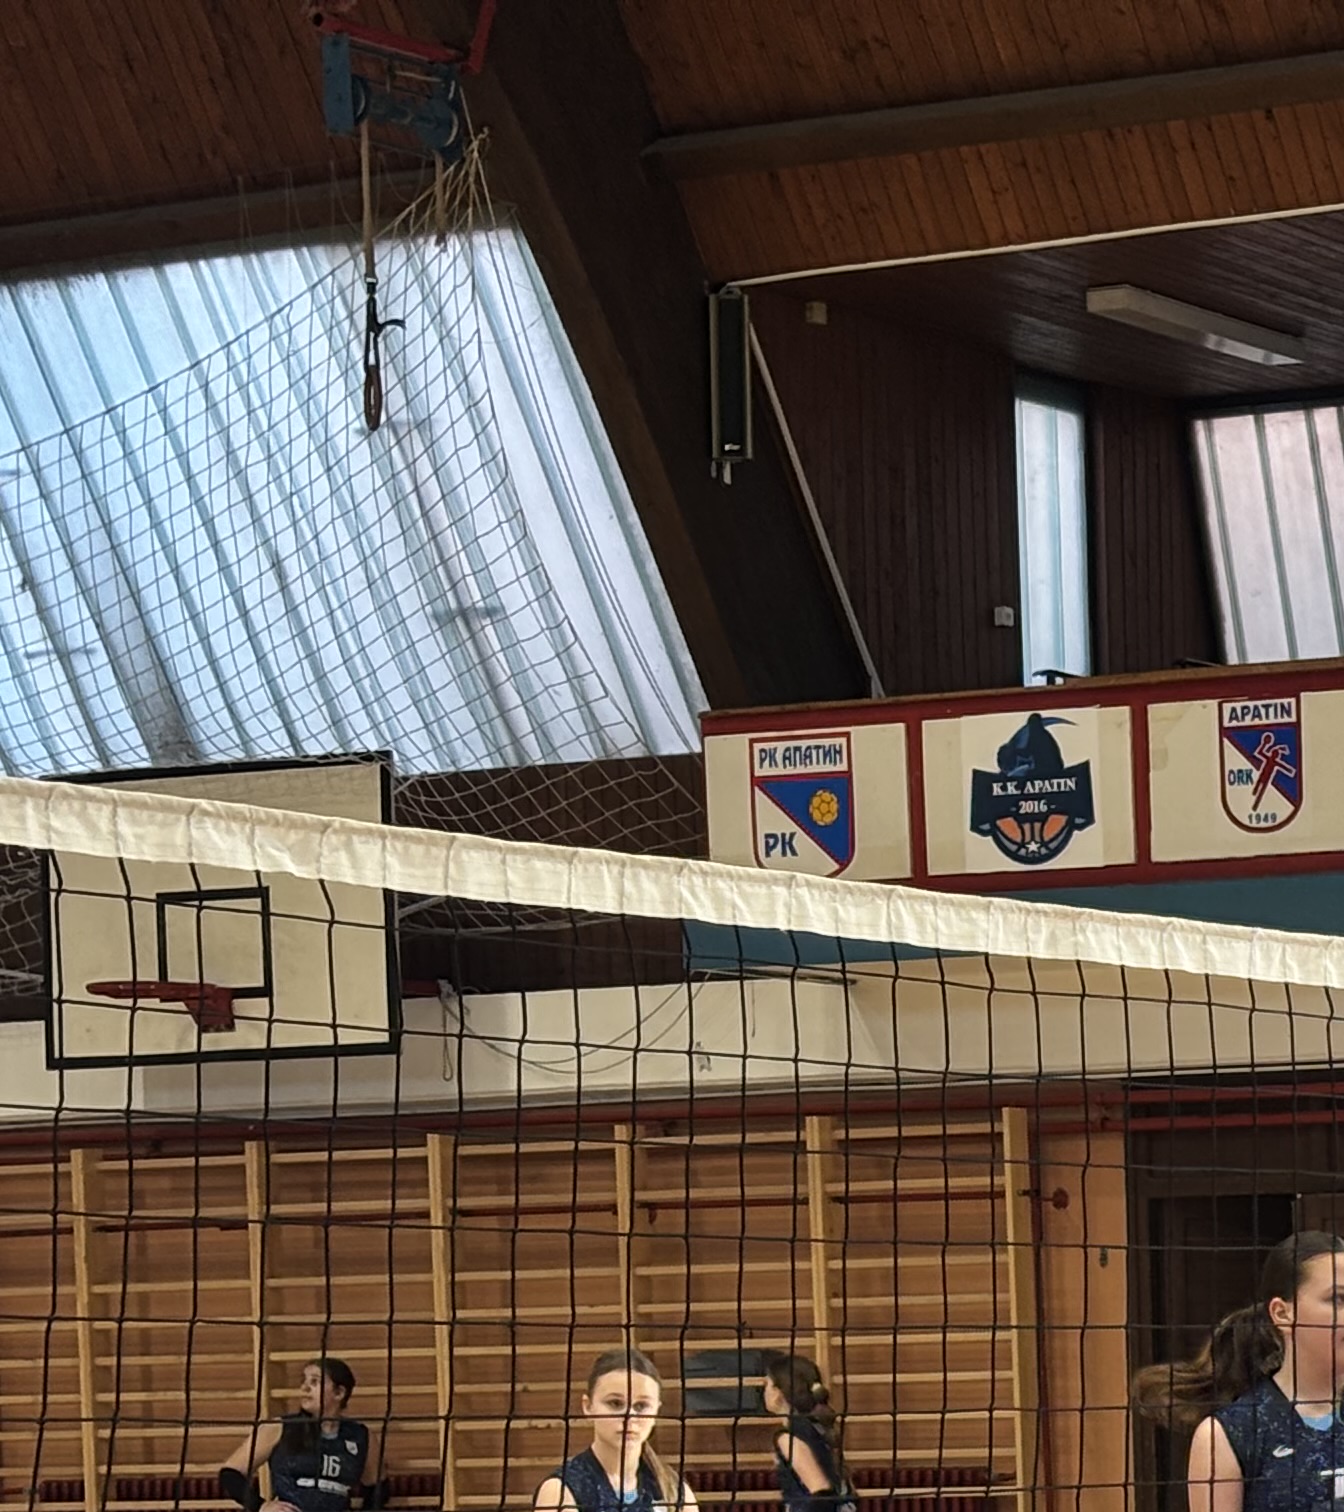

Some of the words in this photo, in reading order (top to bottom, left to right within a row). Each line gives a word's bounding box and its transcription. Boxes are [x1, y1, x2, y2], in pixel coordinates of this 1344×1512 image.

[1228, 701, 1292, 724] APATIN
[758, 748, 779, 769] РК
[782, 743, 844, 769] АПАТИН
[1023, 777, 1077, 795] APATIN
[1018, 800, 1048, 815] 2016
[1248, 812, 1278, 825] 1949
[321, 1454, 341, 1478] 16
